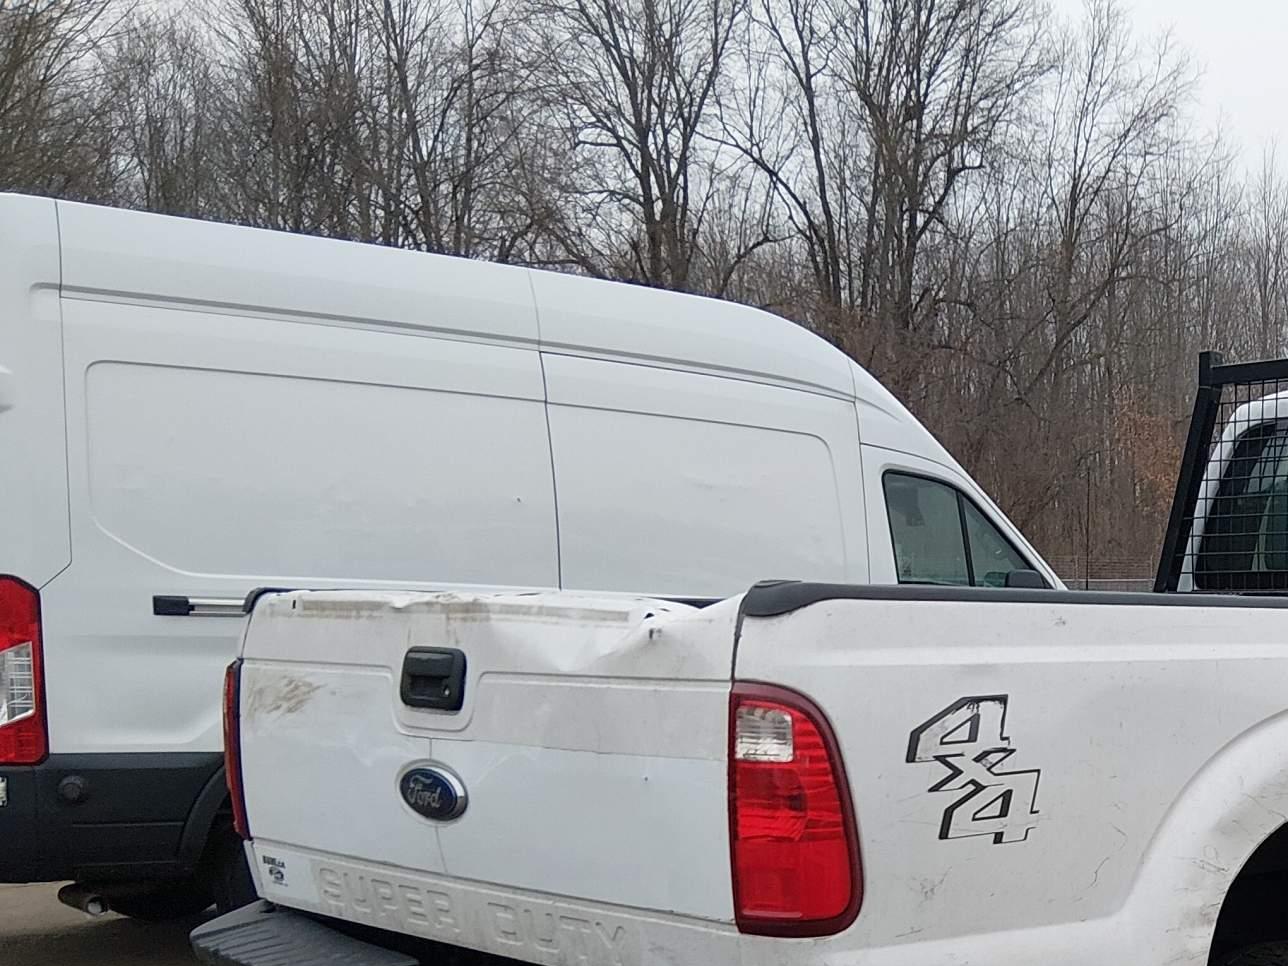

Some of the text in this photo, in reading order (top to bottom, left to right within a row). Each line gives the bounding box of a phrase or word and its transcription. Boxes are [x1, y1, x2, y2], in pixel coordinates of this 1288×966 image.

[407, 775, 442, 808] Ford
[318, 867, 626, 966] SUPER DUTY
